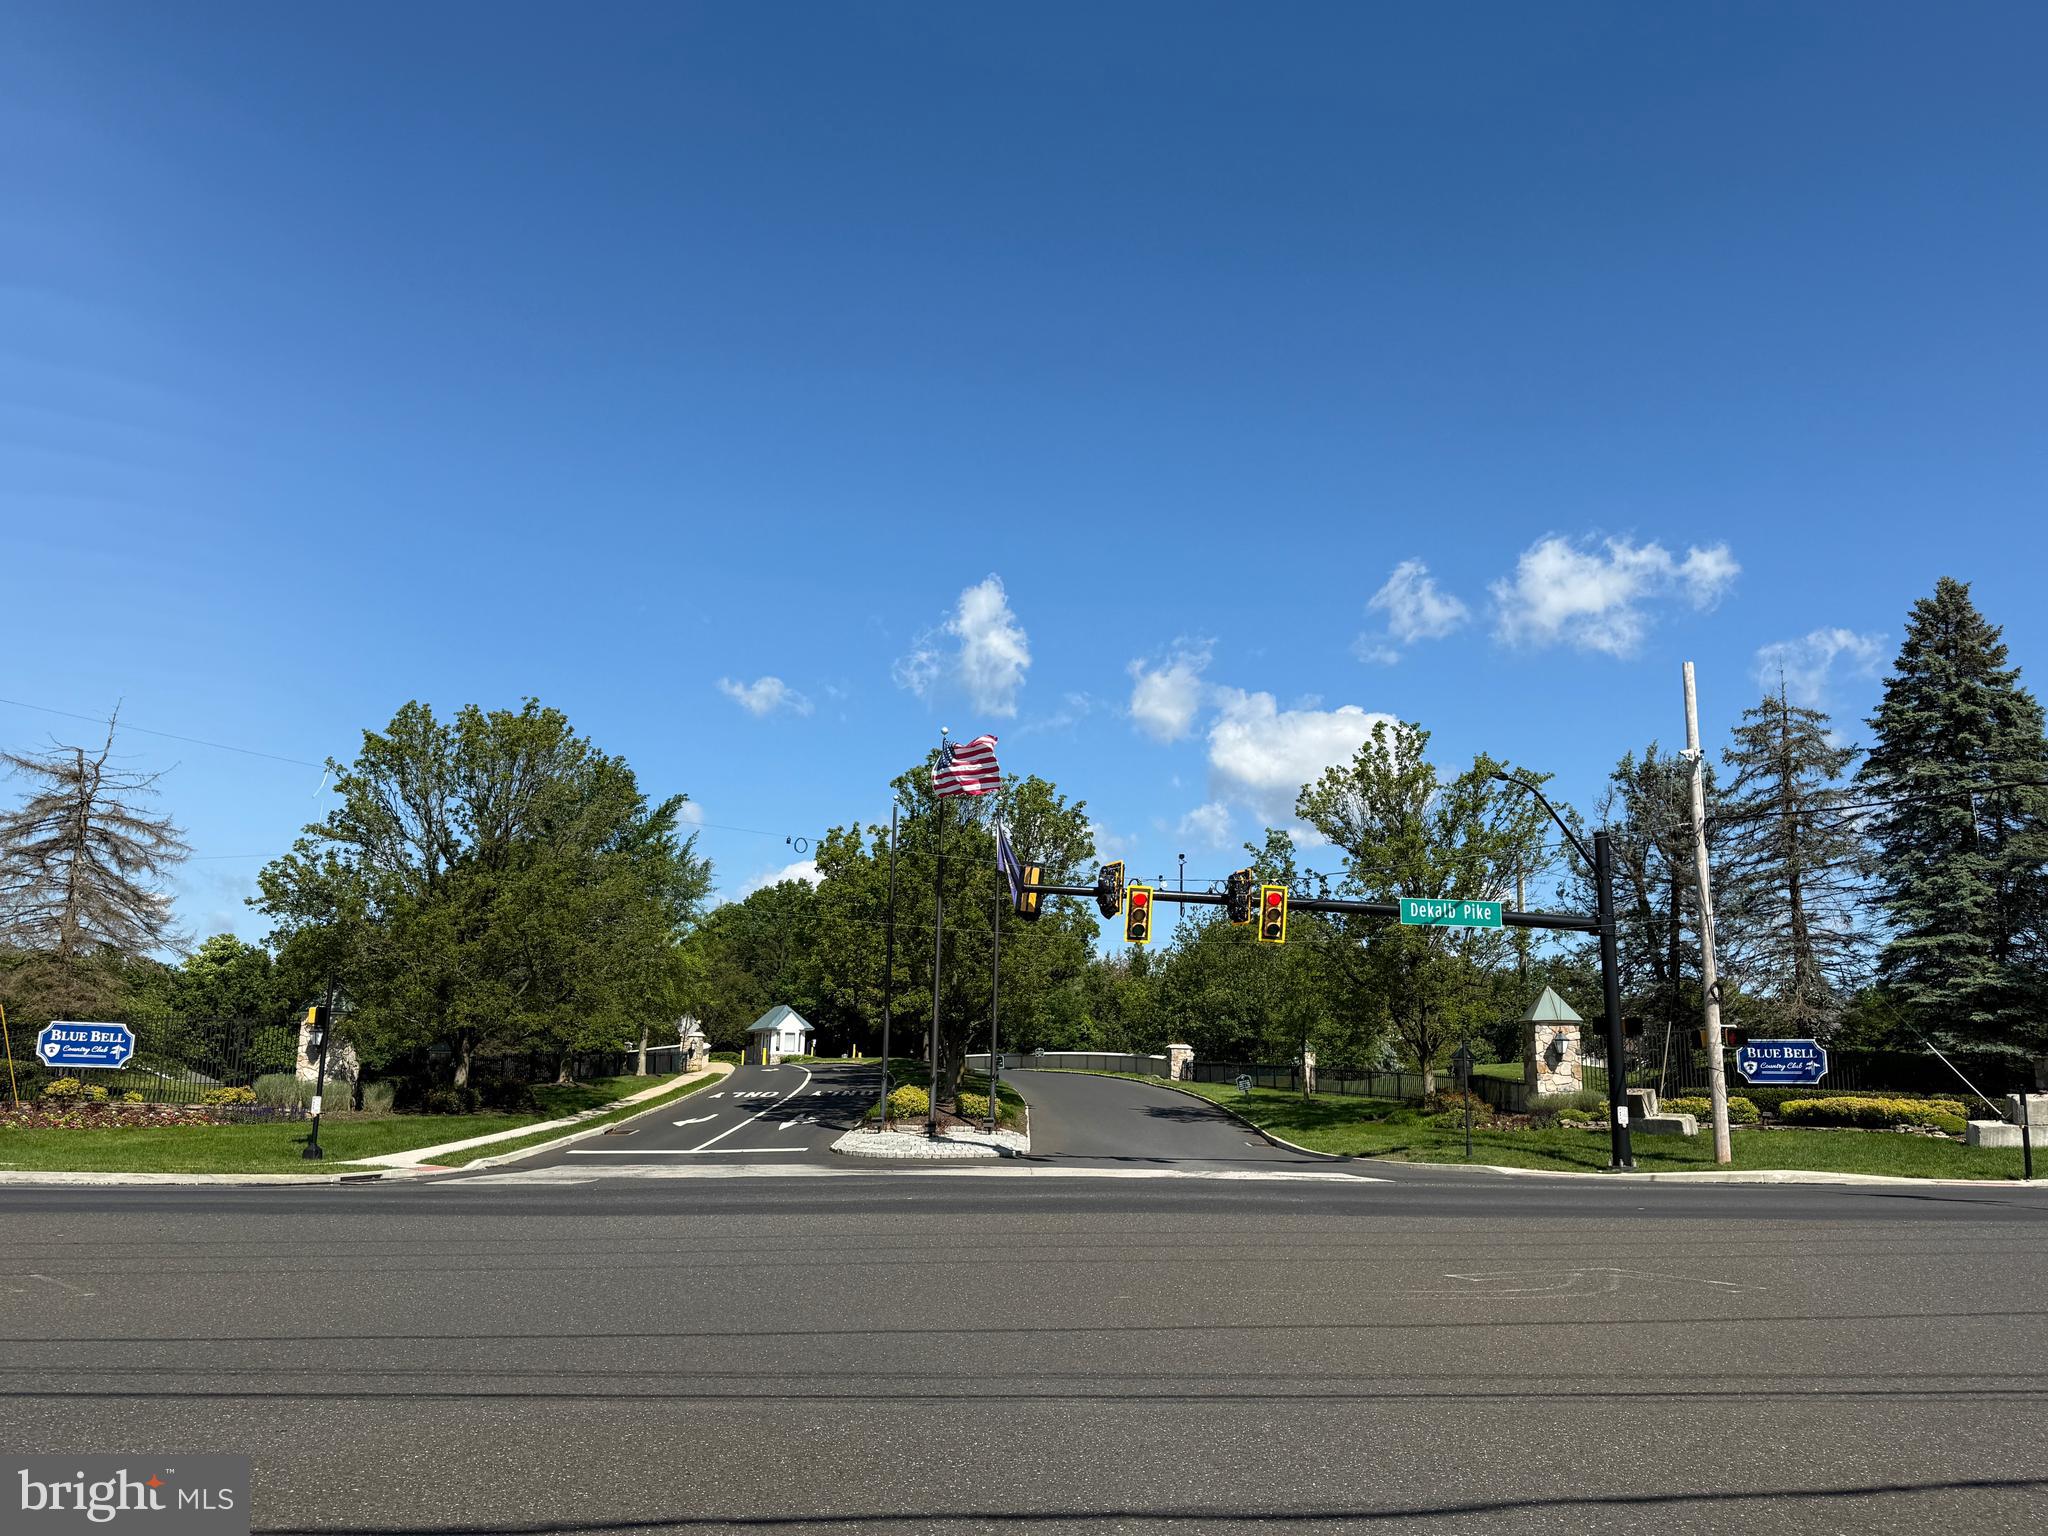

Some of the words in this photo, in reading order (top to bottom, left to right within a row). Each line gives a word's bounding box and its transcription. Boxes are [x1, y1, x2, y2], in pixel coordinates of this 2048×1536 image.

[1410, 902, 1456, 918] Dekalb
[1464, 903, 1491, 920] Pike
[50, 1029, 88, 1042] BLUE
[90, 1030, 126, 1043] BELL
[62, 1045, 91, 1055] Country
[91, 1045, 109, 1053] Club
[1747, 1047, 1782, 1058] BLUE
[1783, 1047, 1818, 1059] BELL
[1760, 1062, 1786, 1072] Country
[708, 1091, 779, 1099] ONLY
